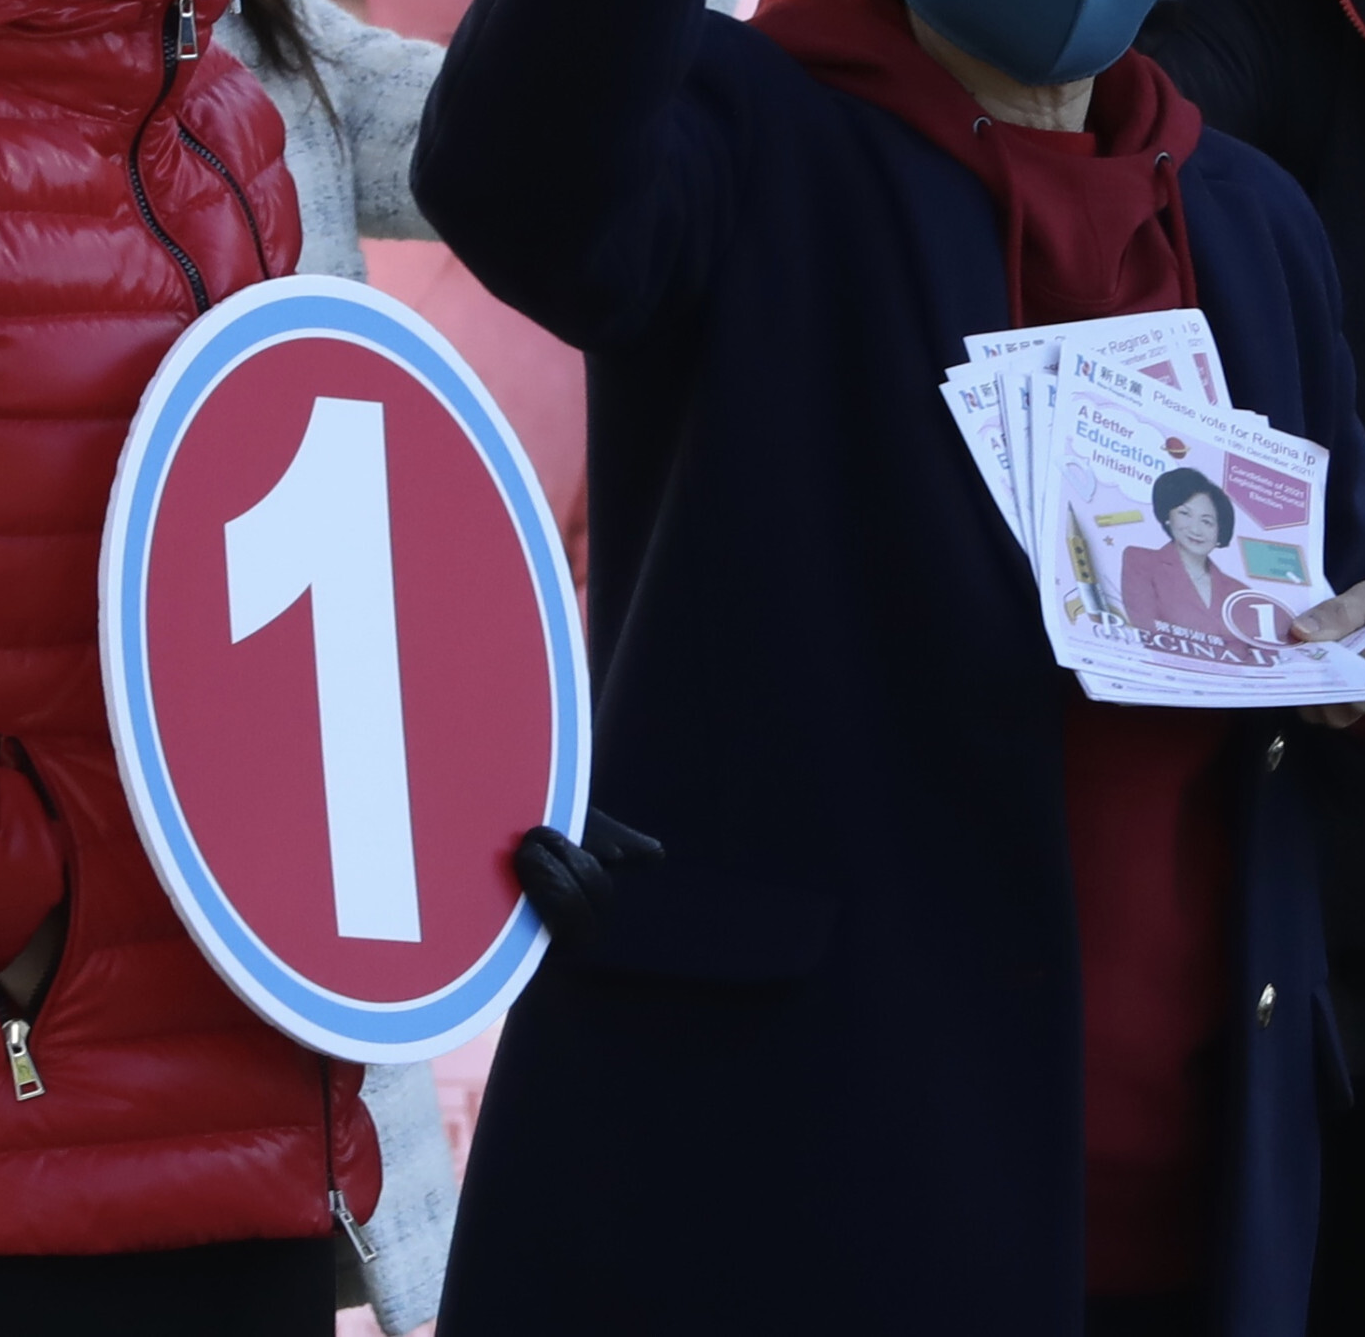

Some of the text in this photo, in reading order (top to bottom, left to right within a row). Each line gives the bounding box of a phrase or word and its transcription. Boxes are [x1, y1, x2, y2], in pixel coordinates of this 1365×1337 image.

[1075, 419, 1167, 472] Education
[1078, 405, 1135, 440] A Better
[1153, 389, 1197, 420] Please
[1199, 413, 1227, 432] vote
[1230, 423, 1248, 440] for
[1252, 432, 1299, 459] Regina
[1303, 451, 1317, 466] Ip
[1092, 449, 1154, 486] Initiative
[1248, 603, 1286, 646] 1
[223, 395, 422, 943] 1
